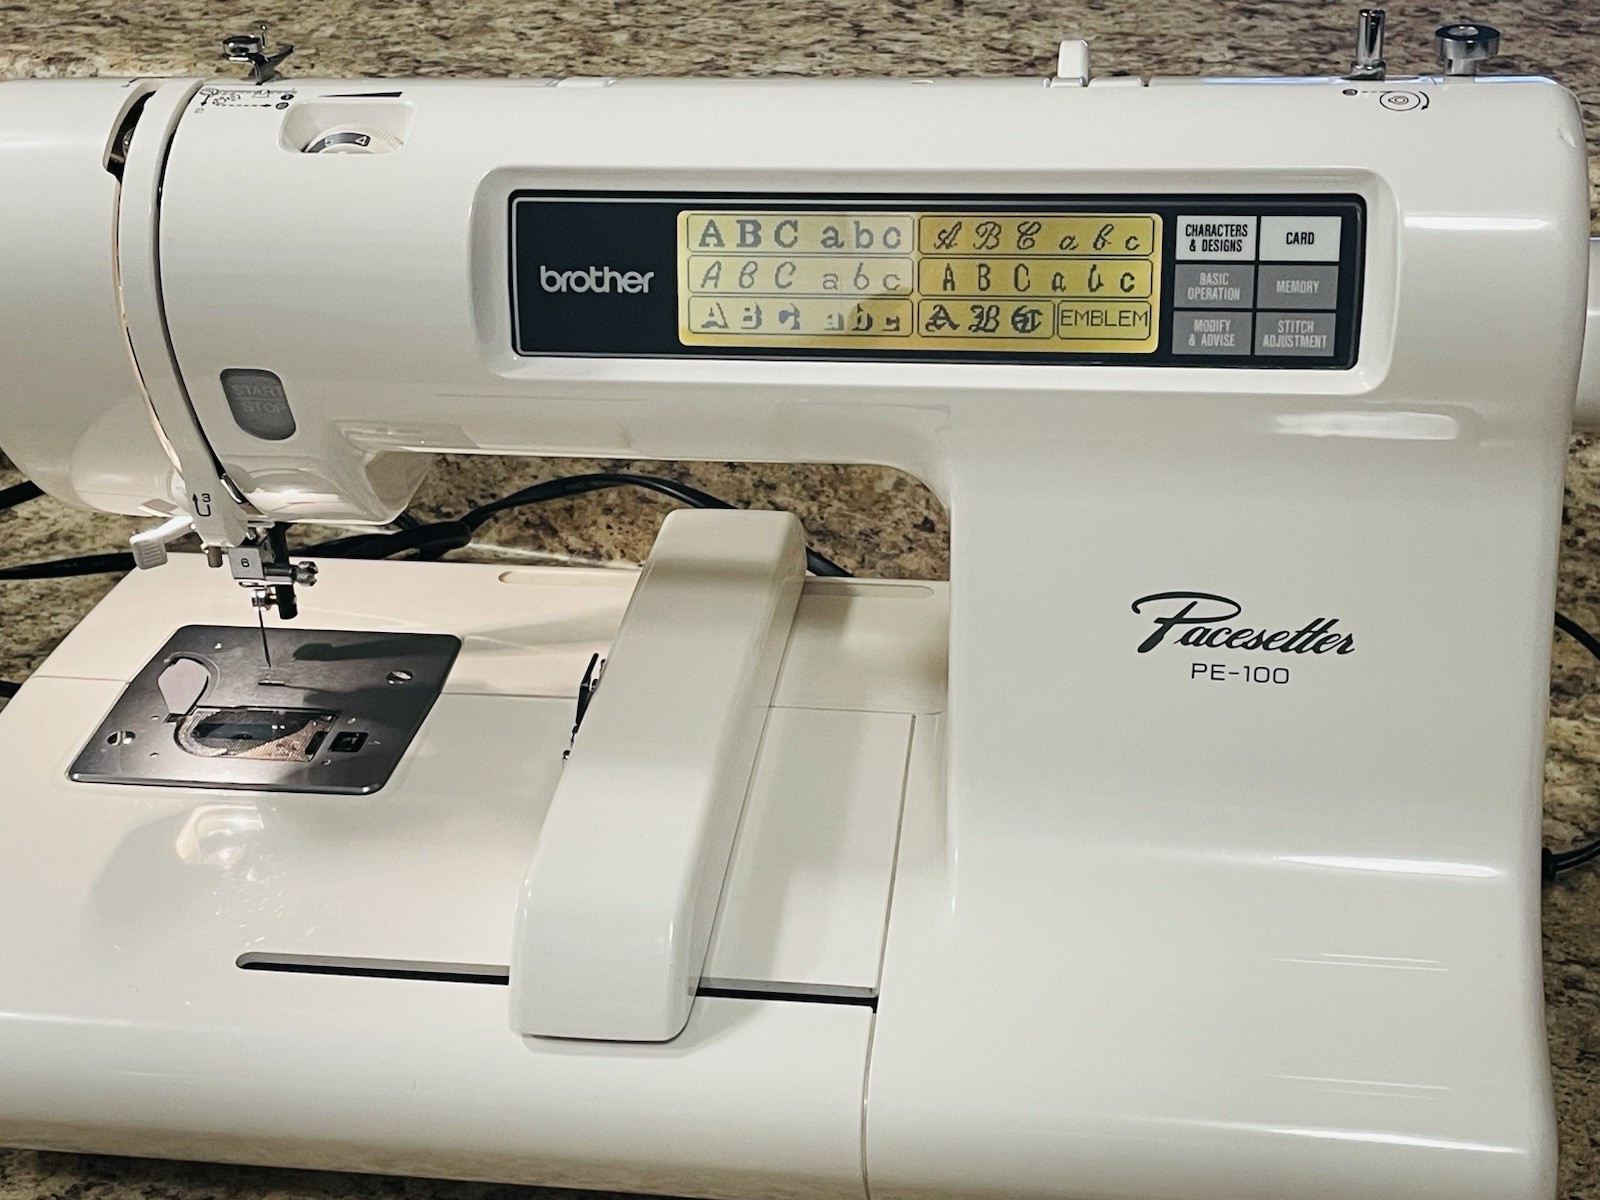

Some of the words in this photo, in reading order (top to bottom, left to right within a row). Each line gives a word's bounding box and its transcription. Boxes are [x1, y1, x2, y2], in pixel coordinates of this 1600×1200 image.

[354, 135, 368, 146] 4
[1185, 223, 1248, 238] CHARACTERS
[1286, 231, 1315, 245] CARD
[1189, 239, 1196, 252] &
[1202, 239, 1243, 252] DESIGNS
[540, 265, 655, 293] brother
[1200, 272, 1229, 286] BASIC
[1187, 287, 1241, 301] OPERATION
[1276, 280, 1320, 294] MEMORY
[1060, 309, 1149, 327] EMBLEM
[1193, 319, 1232, 333] MODIFY
[1277, 320, 1315, 334] STITCH
[1188, 334, 1196, 347] &
[1200, 334, 1235, 347] ADVISE
[1262, 335, 1328, 349] ADJUSTMENT
[231, 384, 283, 397] START
[241, 400, 287, 413] STOP
[202, 493, 211, 503] 3
[1131, 591, 1355, 655] Pacesetter
[1191, 662, 1289, 684] PE-100
